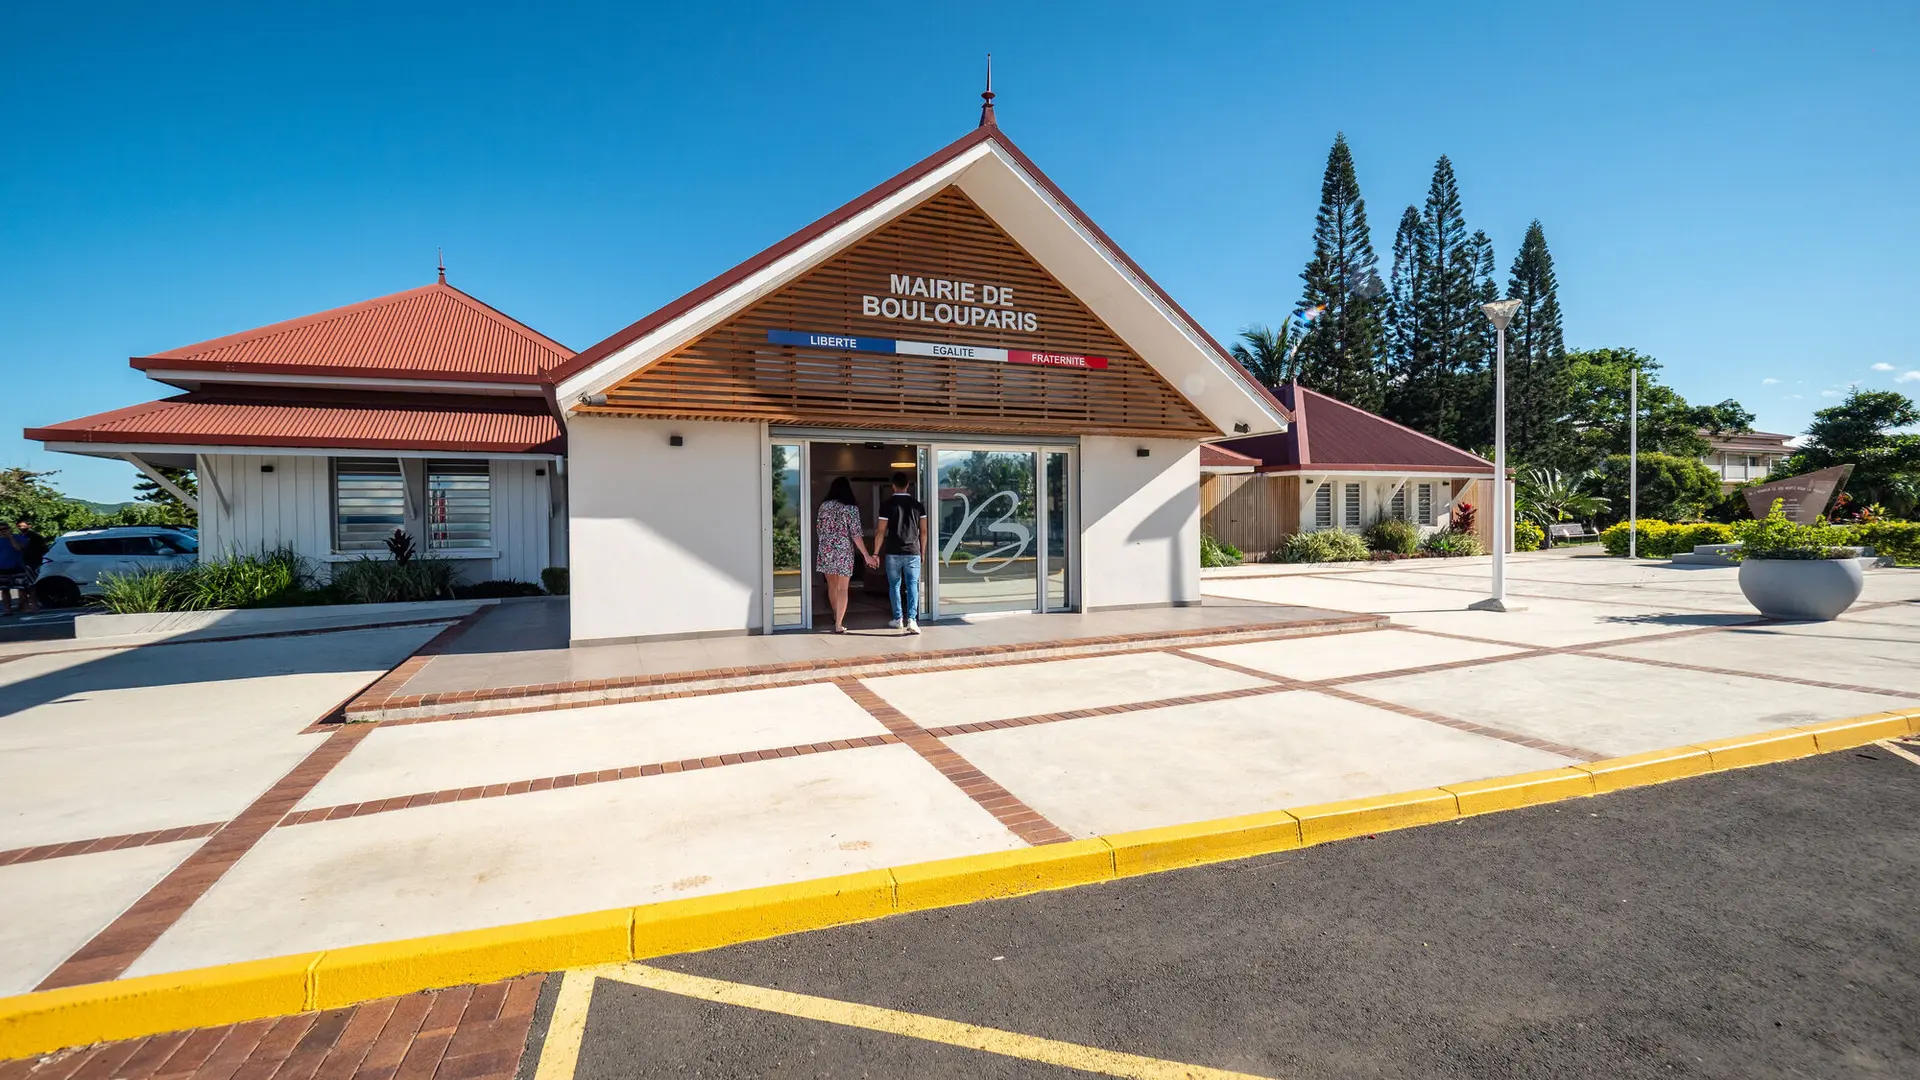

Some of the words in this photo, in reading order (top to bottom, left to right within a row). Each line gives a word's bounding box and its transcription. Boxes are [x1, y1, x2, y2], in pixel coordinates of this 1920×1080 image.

[890, 274, 975, 302] MAIRIE
[983, 285, 1014, 307] DE
[862, 295, 1038, 332] BOULOUPARIS
[810, 335, 857, 348] LIBERTE
[932, 345, 975, 357] EGALITE
[1031, 353, 1085, 366] FRATERNITE
